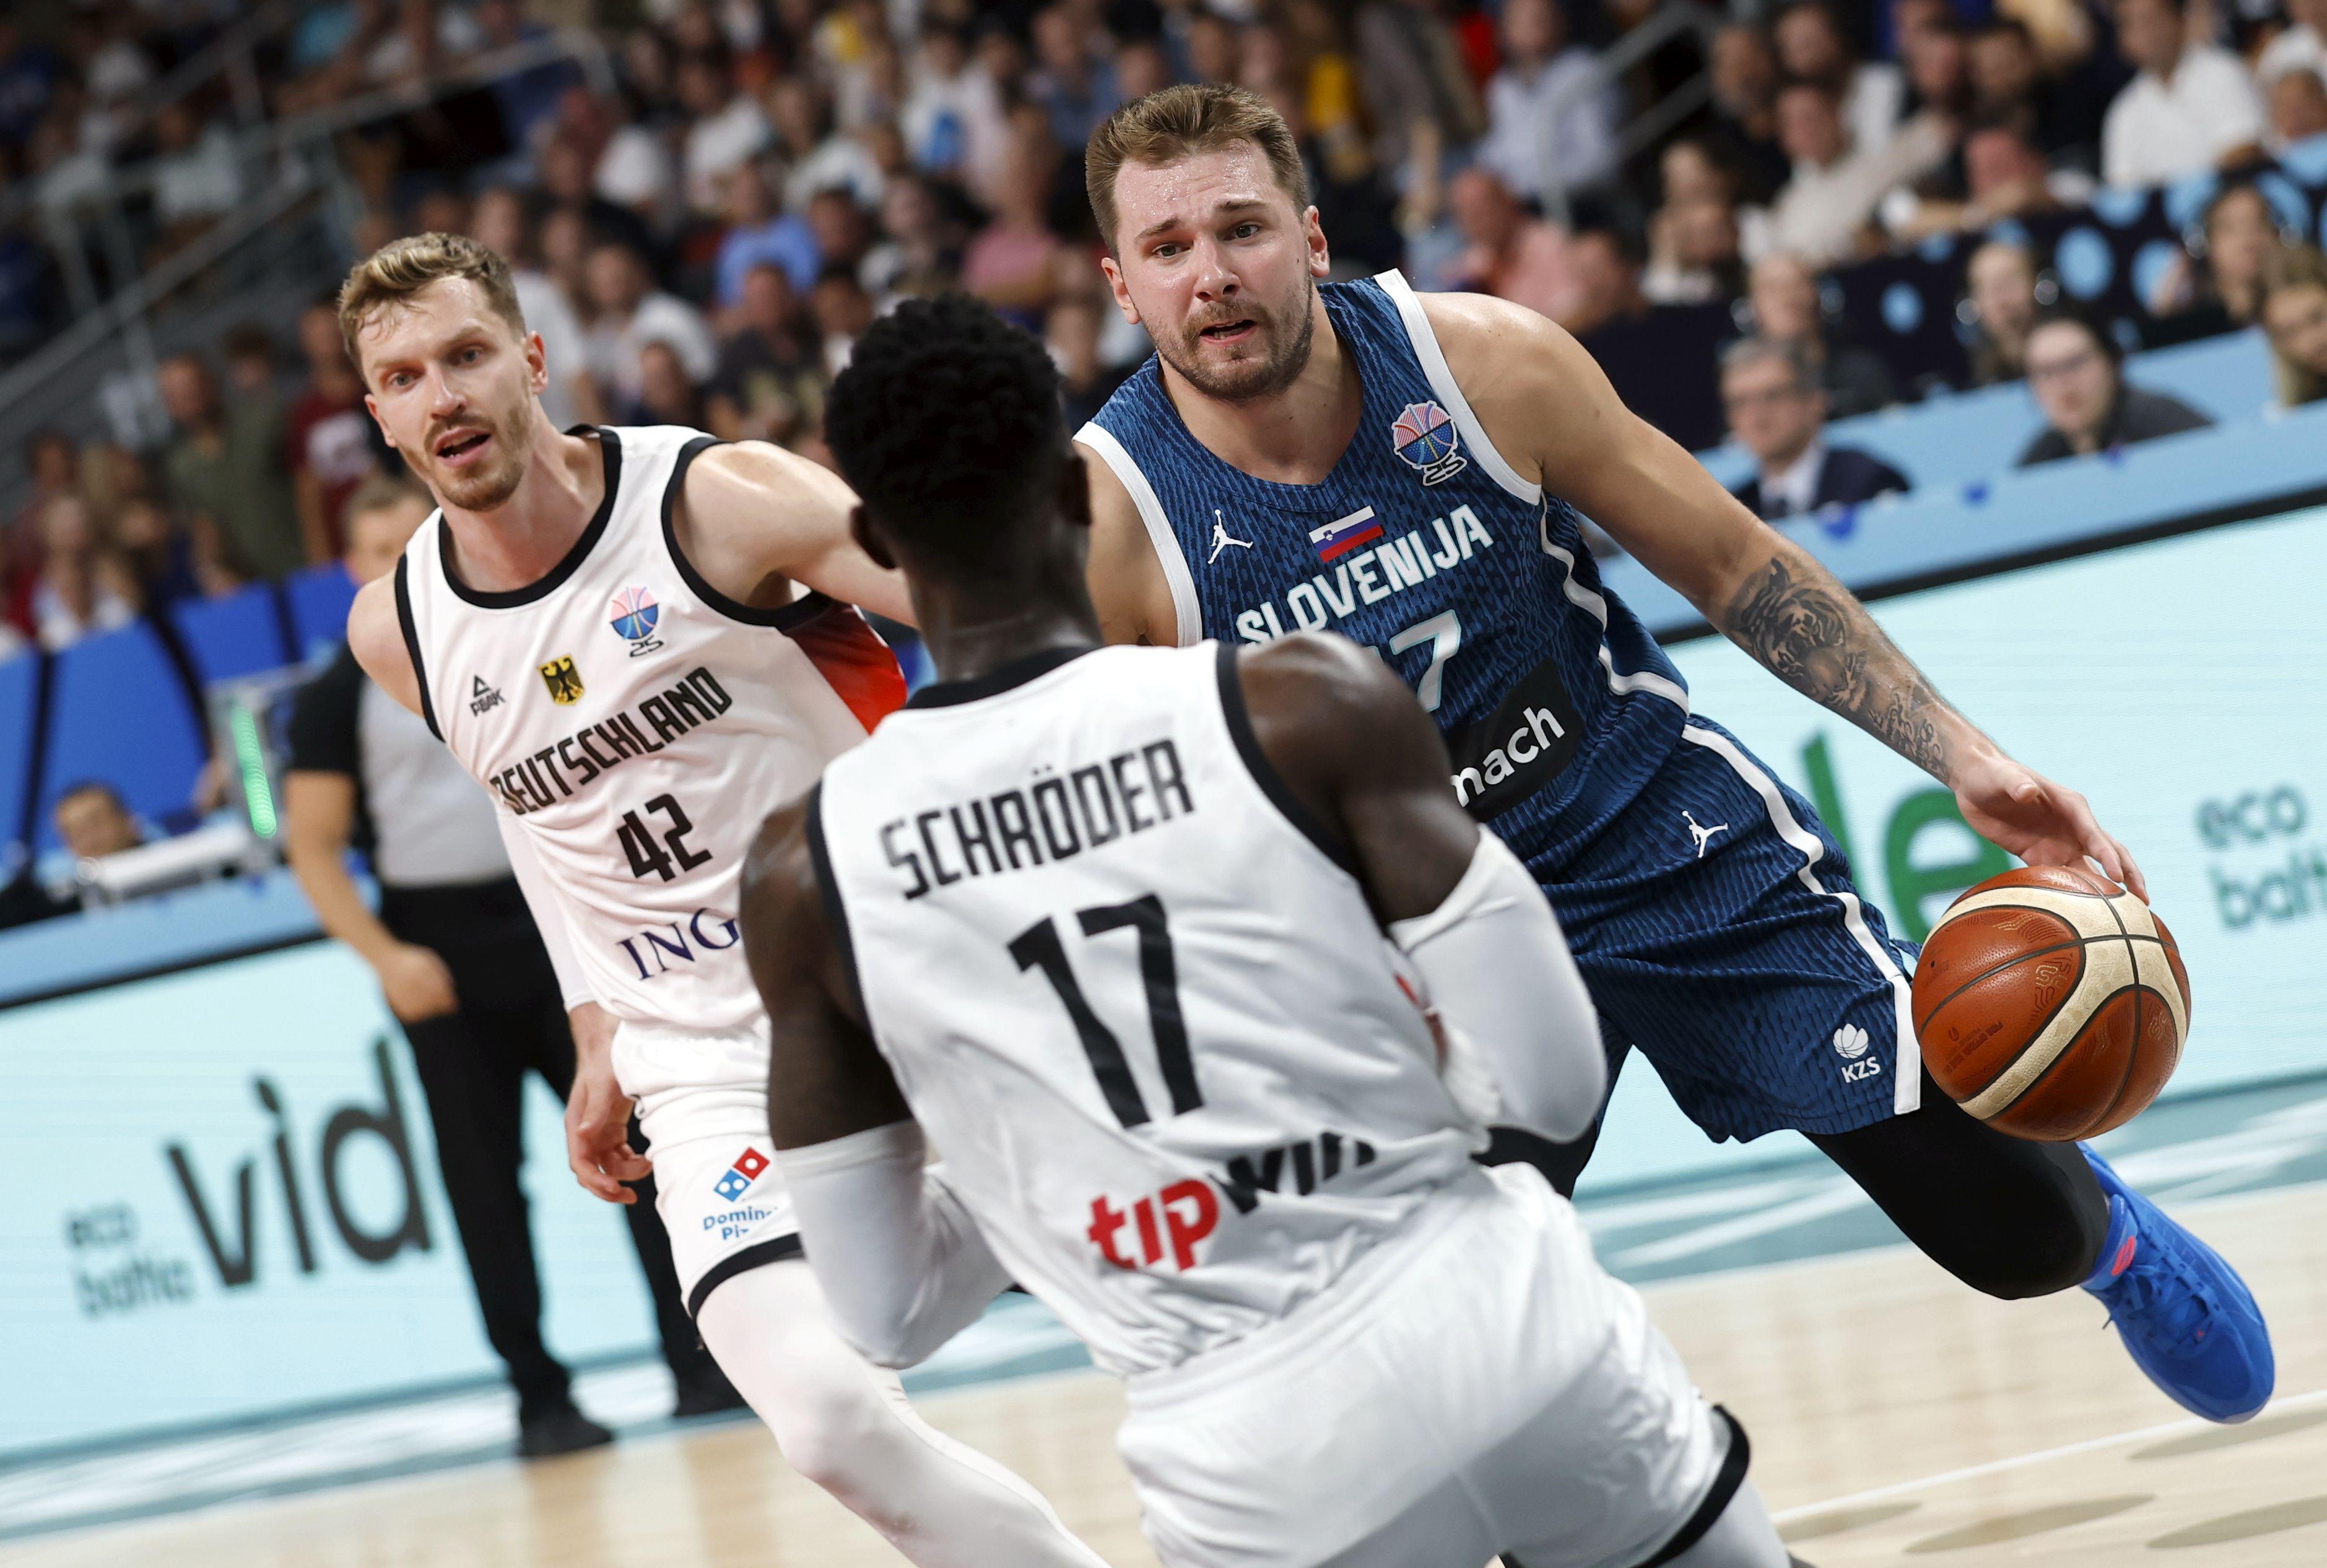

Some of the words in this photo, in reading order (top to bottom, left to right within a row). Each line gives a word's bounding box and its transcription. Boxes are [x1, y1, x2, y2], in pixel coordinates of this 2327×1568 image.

[1424, 453, 1466, 485] 25
[1236, 504, 1494, 648] SLOVENIJA
[1360, 609, 1461, 713] 7
[470, 689, 506, 717] PEAK
[616, 793, 713, 882] 42
[879, 738, 1195, 901] SCHRÖDER
[2196, 785, 2307, 849] eco
[616, 907, 740, 981] ING
[1007, 892, 1204, 1129] 17
[1841, 1056, 1881, 1083] KZS
[163, 1034, 435, 1288] vid
[703, 1205, 778, 1231] Domin
